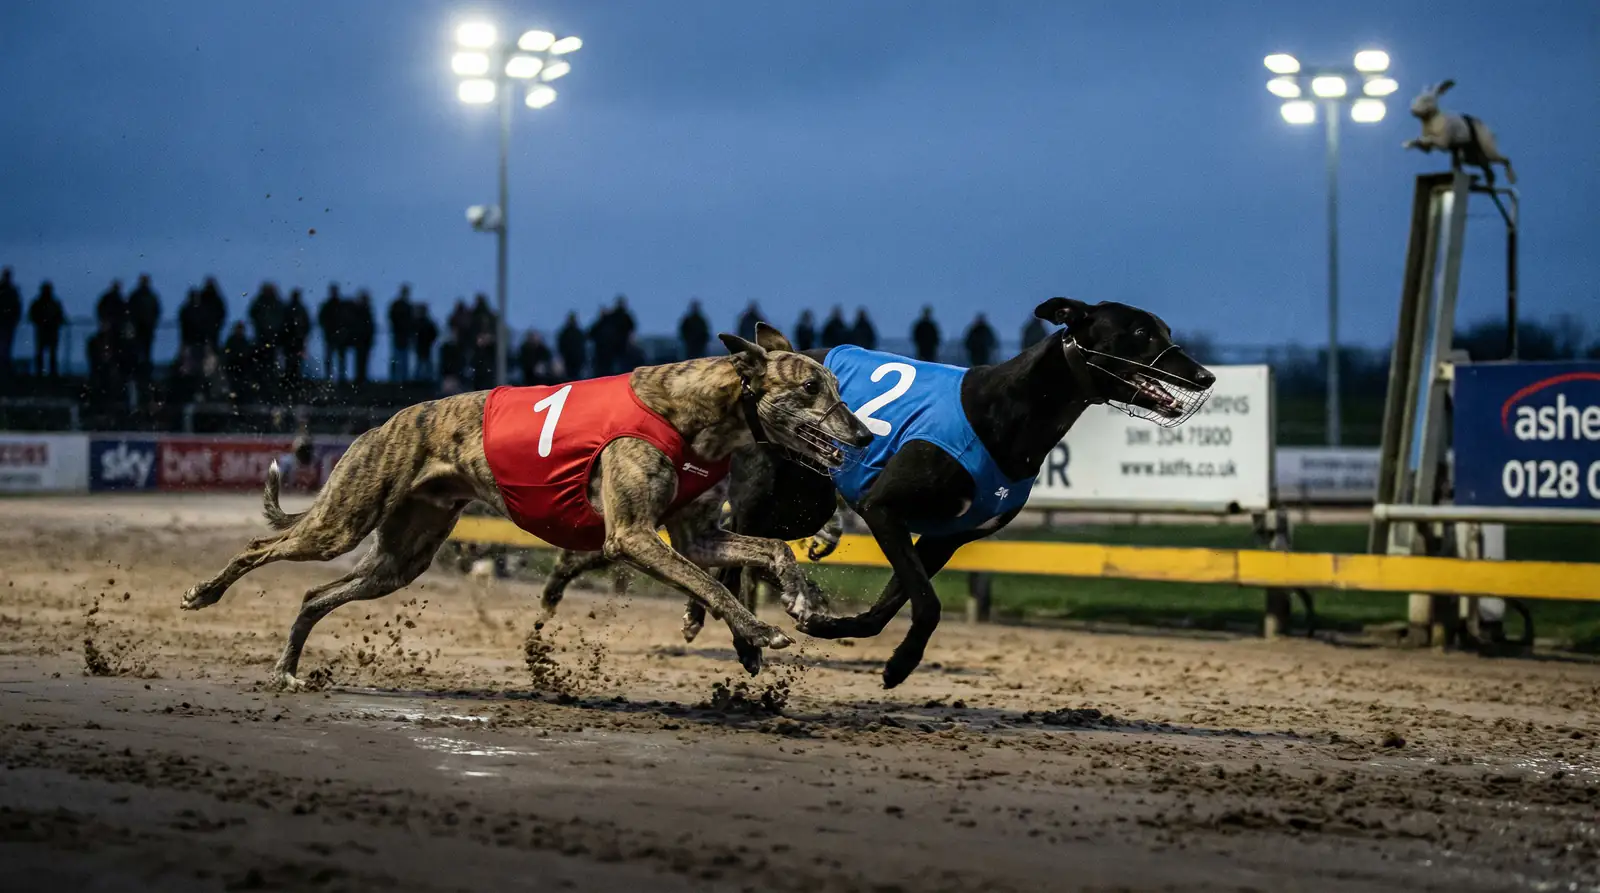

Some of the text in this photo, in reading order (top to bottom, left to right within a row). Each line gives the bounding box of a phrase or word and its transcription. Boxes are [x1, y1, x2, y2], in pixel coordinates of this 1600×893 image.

[533, 384, 573, 458] 1
[854, 362, 917, 437] 2
[1514, 392, 1600, 441] ashe
[100, 440, 155, 487] sky
[1502, 459, 1580, 499] 0128
